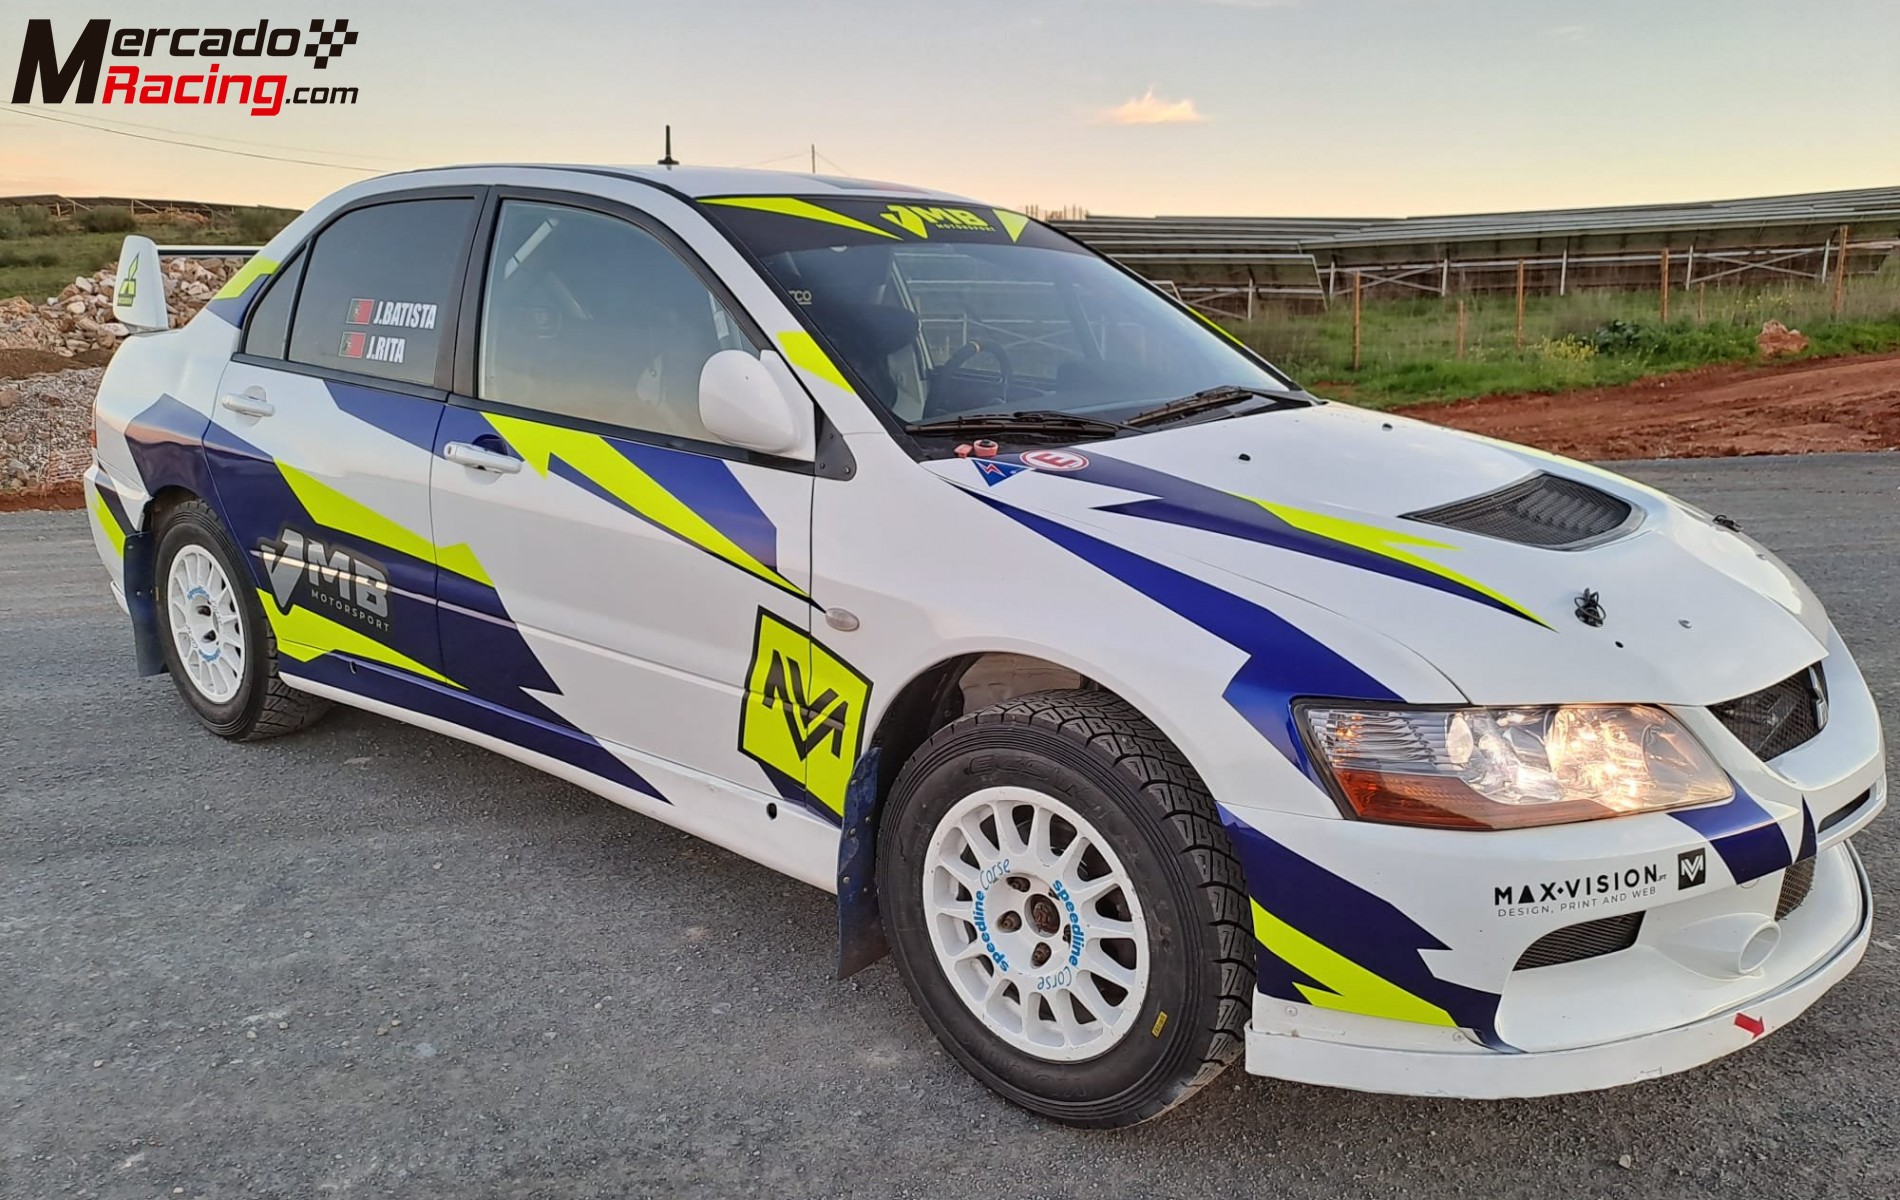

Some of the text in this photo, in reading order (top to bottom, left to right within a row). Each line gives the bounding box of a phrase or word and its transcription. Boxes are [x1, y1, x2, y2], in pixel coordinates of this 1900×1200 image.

[935, 223, 996, 232] MOTORSPORT
[373, 300, 438, 330] J.BATISTA
[366, 335, 406, 364] J.RITA
[1031, 452, 1077, 468] E
[311, 589, 390, 632] MOTORSPORT
[972, 857, 1011, 972] speedline Corse
[1498, 886, 1656, 917] DESIGN, PRINT AND WEB
[1037, 878, 1086, 991] speedline Corse
